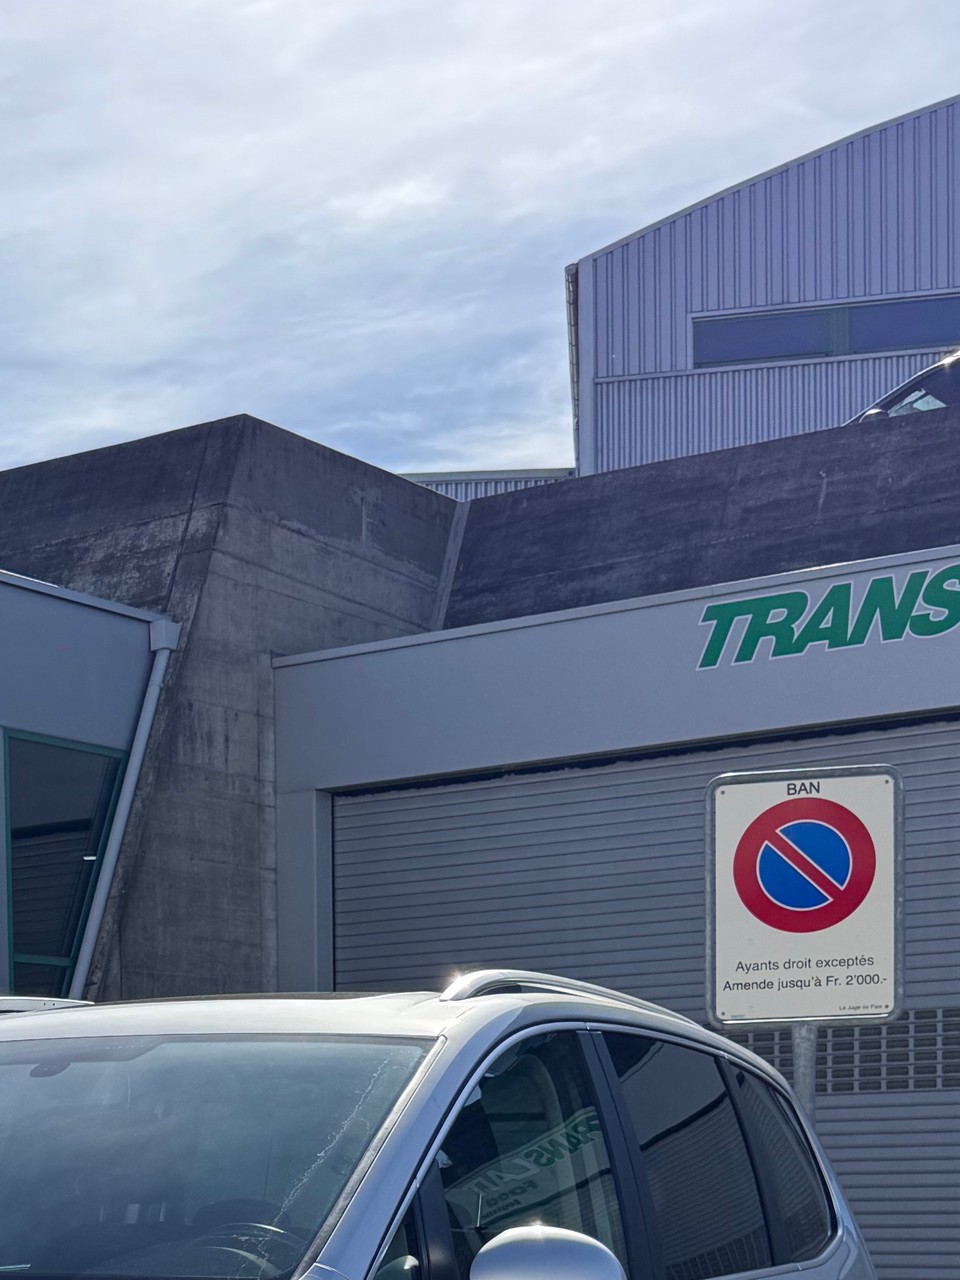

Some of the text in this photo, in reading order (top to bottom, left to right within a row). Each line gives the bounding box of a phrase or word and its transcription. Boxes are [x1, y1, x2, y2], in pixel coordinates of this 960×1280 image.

[695, 562, 960, 672] TRANS
[786, 781, 821, 796] BAN
[735, 954, 875, 974] Ayants droit exceptés
[722, 973, 888, 992] Amende jusqu'à Fr. 2'000.-
